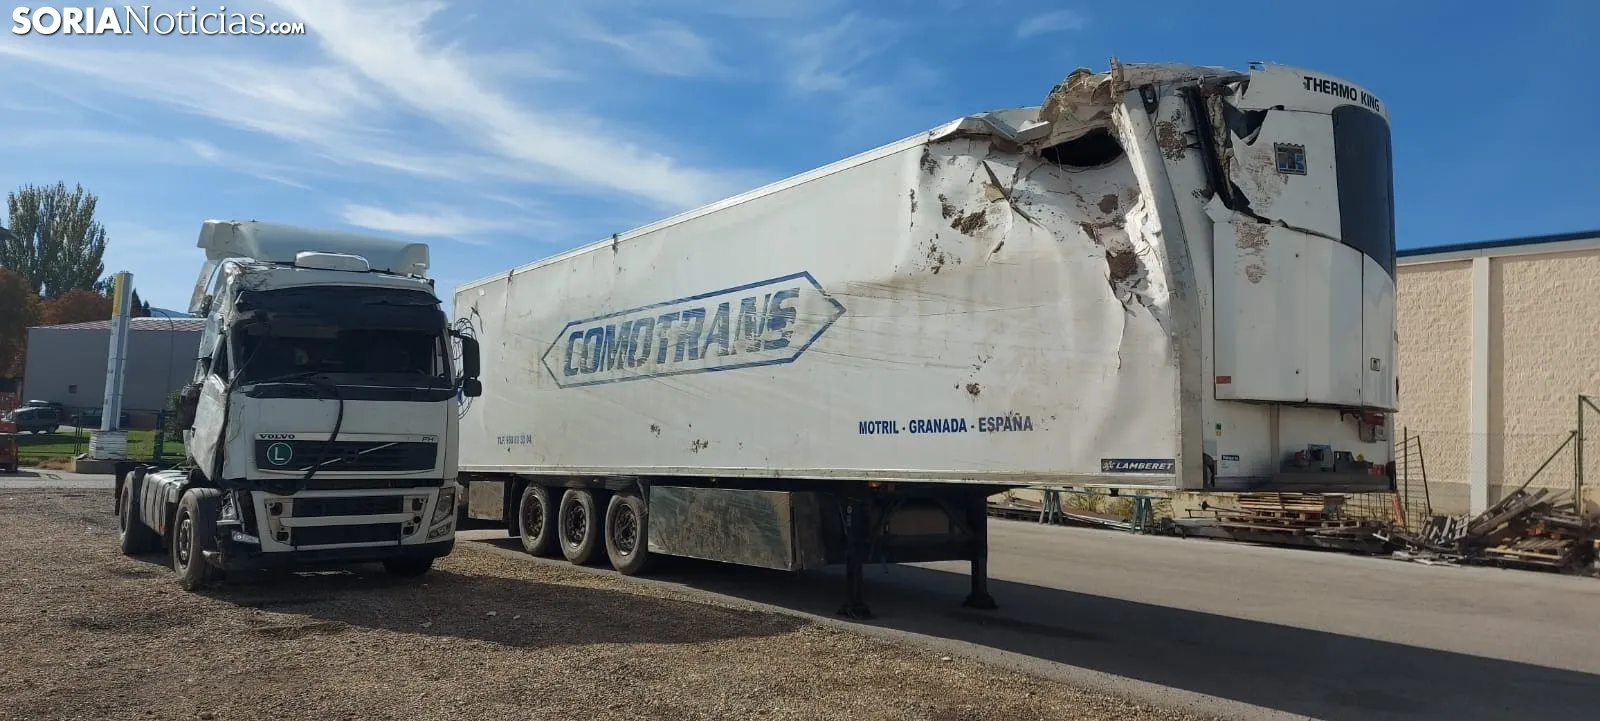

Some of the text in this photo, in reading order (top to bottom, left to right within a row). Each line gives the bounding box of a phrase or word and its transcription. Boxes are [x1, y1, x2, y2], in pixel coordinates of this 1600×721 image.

[1303, 76, 1380, 112] THERMO KING
[564, 287, 800, 377] COMOTRANS
[859, 421, 899, 434] MOTRIL
[909, 418, 967, 433] GRANADA
[978, 411, 1033, 432] ESPAÑA
[274, 448, 285, 461] L
[1116, 462, 1173, 470] LAMBERET
